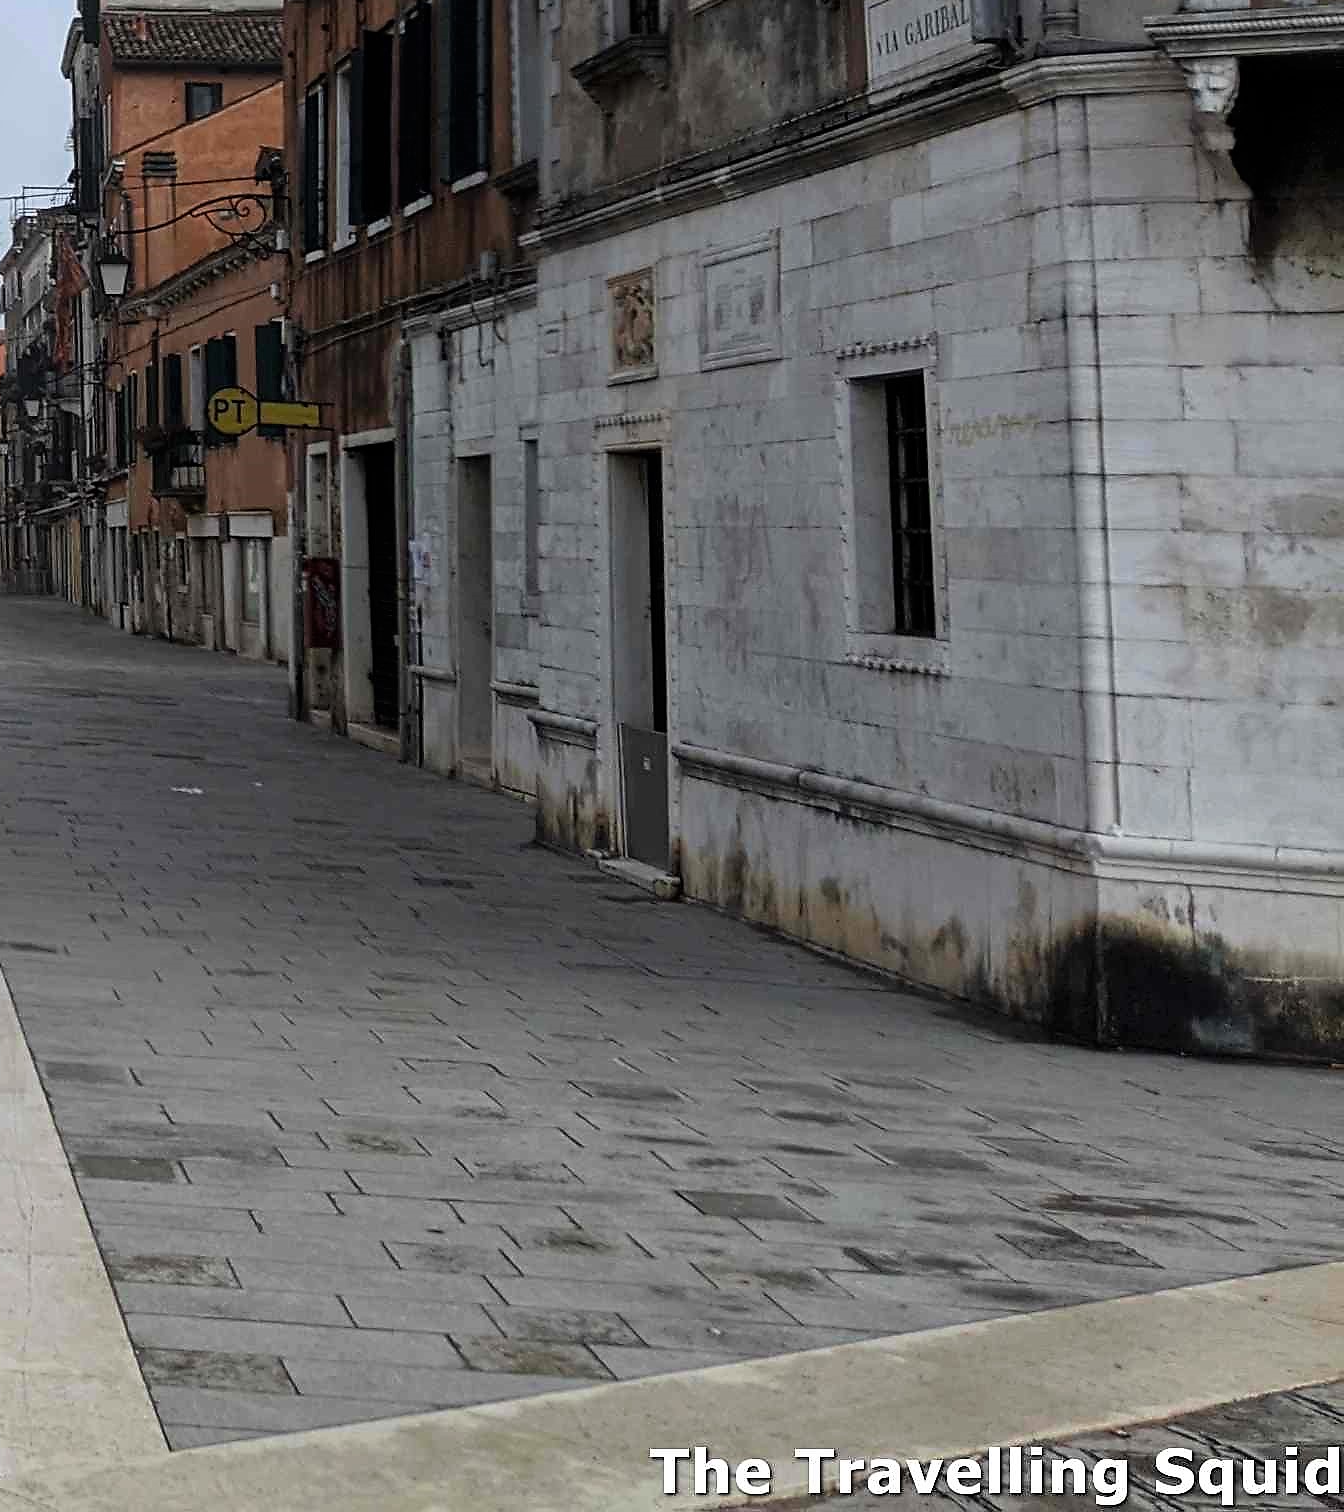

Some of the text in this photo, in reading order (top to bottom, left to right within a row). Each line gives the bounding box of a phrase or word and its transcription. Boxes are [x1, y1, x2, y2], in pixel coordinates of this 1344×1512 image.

[876, 0, 970, 57] VIA GARIBAL
[214, 399, 246, 424] PT
